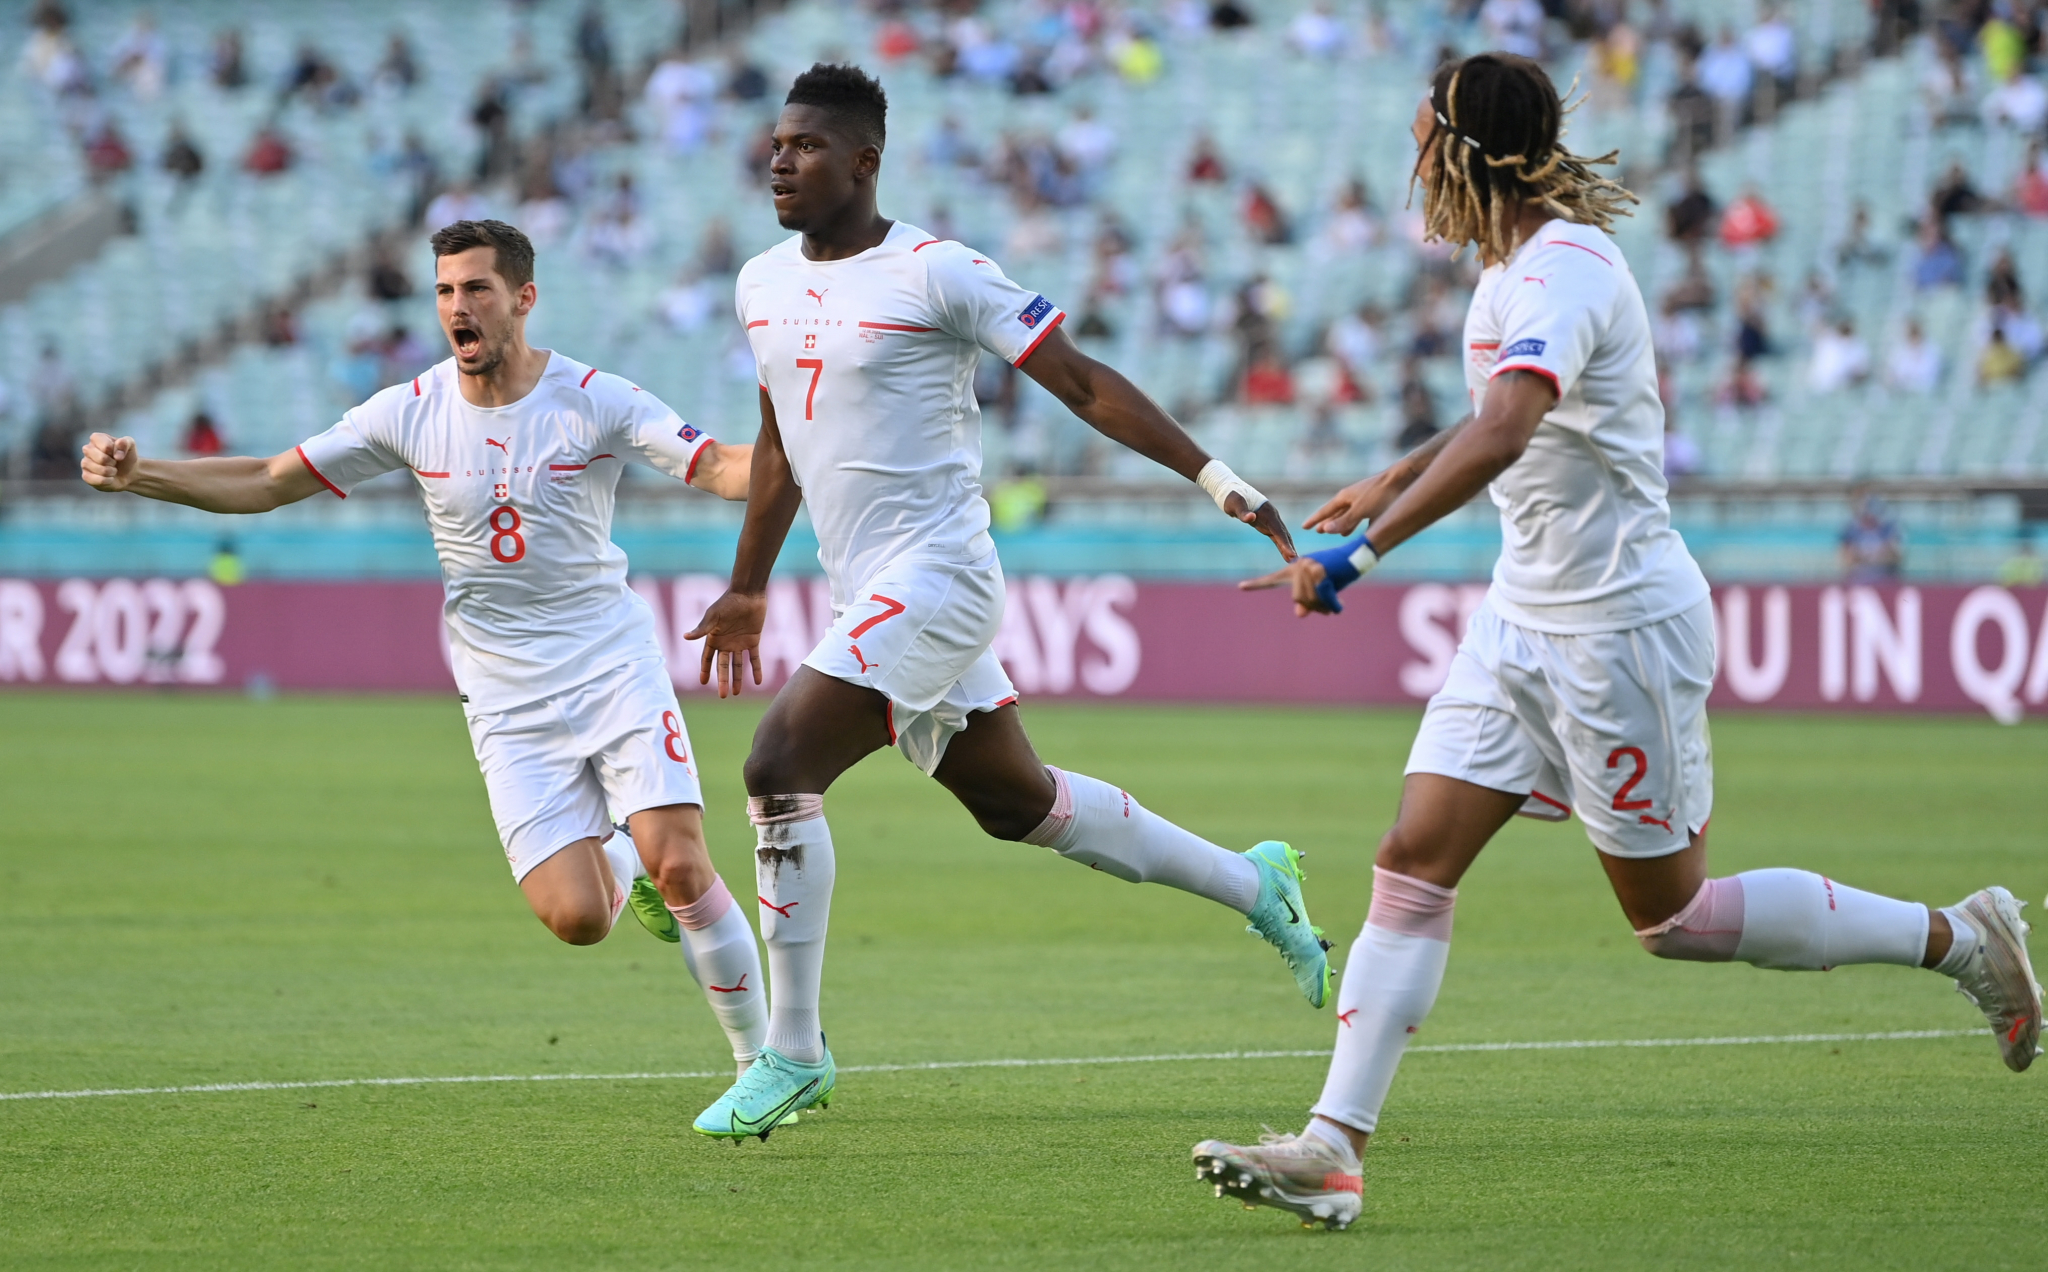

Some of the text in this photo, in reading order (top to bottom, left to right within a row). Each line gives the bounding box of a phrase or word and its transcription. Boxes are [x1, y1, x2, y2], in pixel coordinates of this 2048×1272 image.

[796, 358, 824, 421] 7
[466, 465, 534, 477] suisse
[489, 505, 526, 564] 8
[54, 576, 227, 684] 2022
[848, 593, 906, 640] 7
[1818, 584, 1924, 703] IN
[662, 710, 689, 764] 8
[1607, 747, 1653, 811] 2
